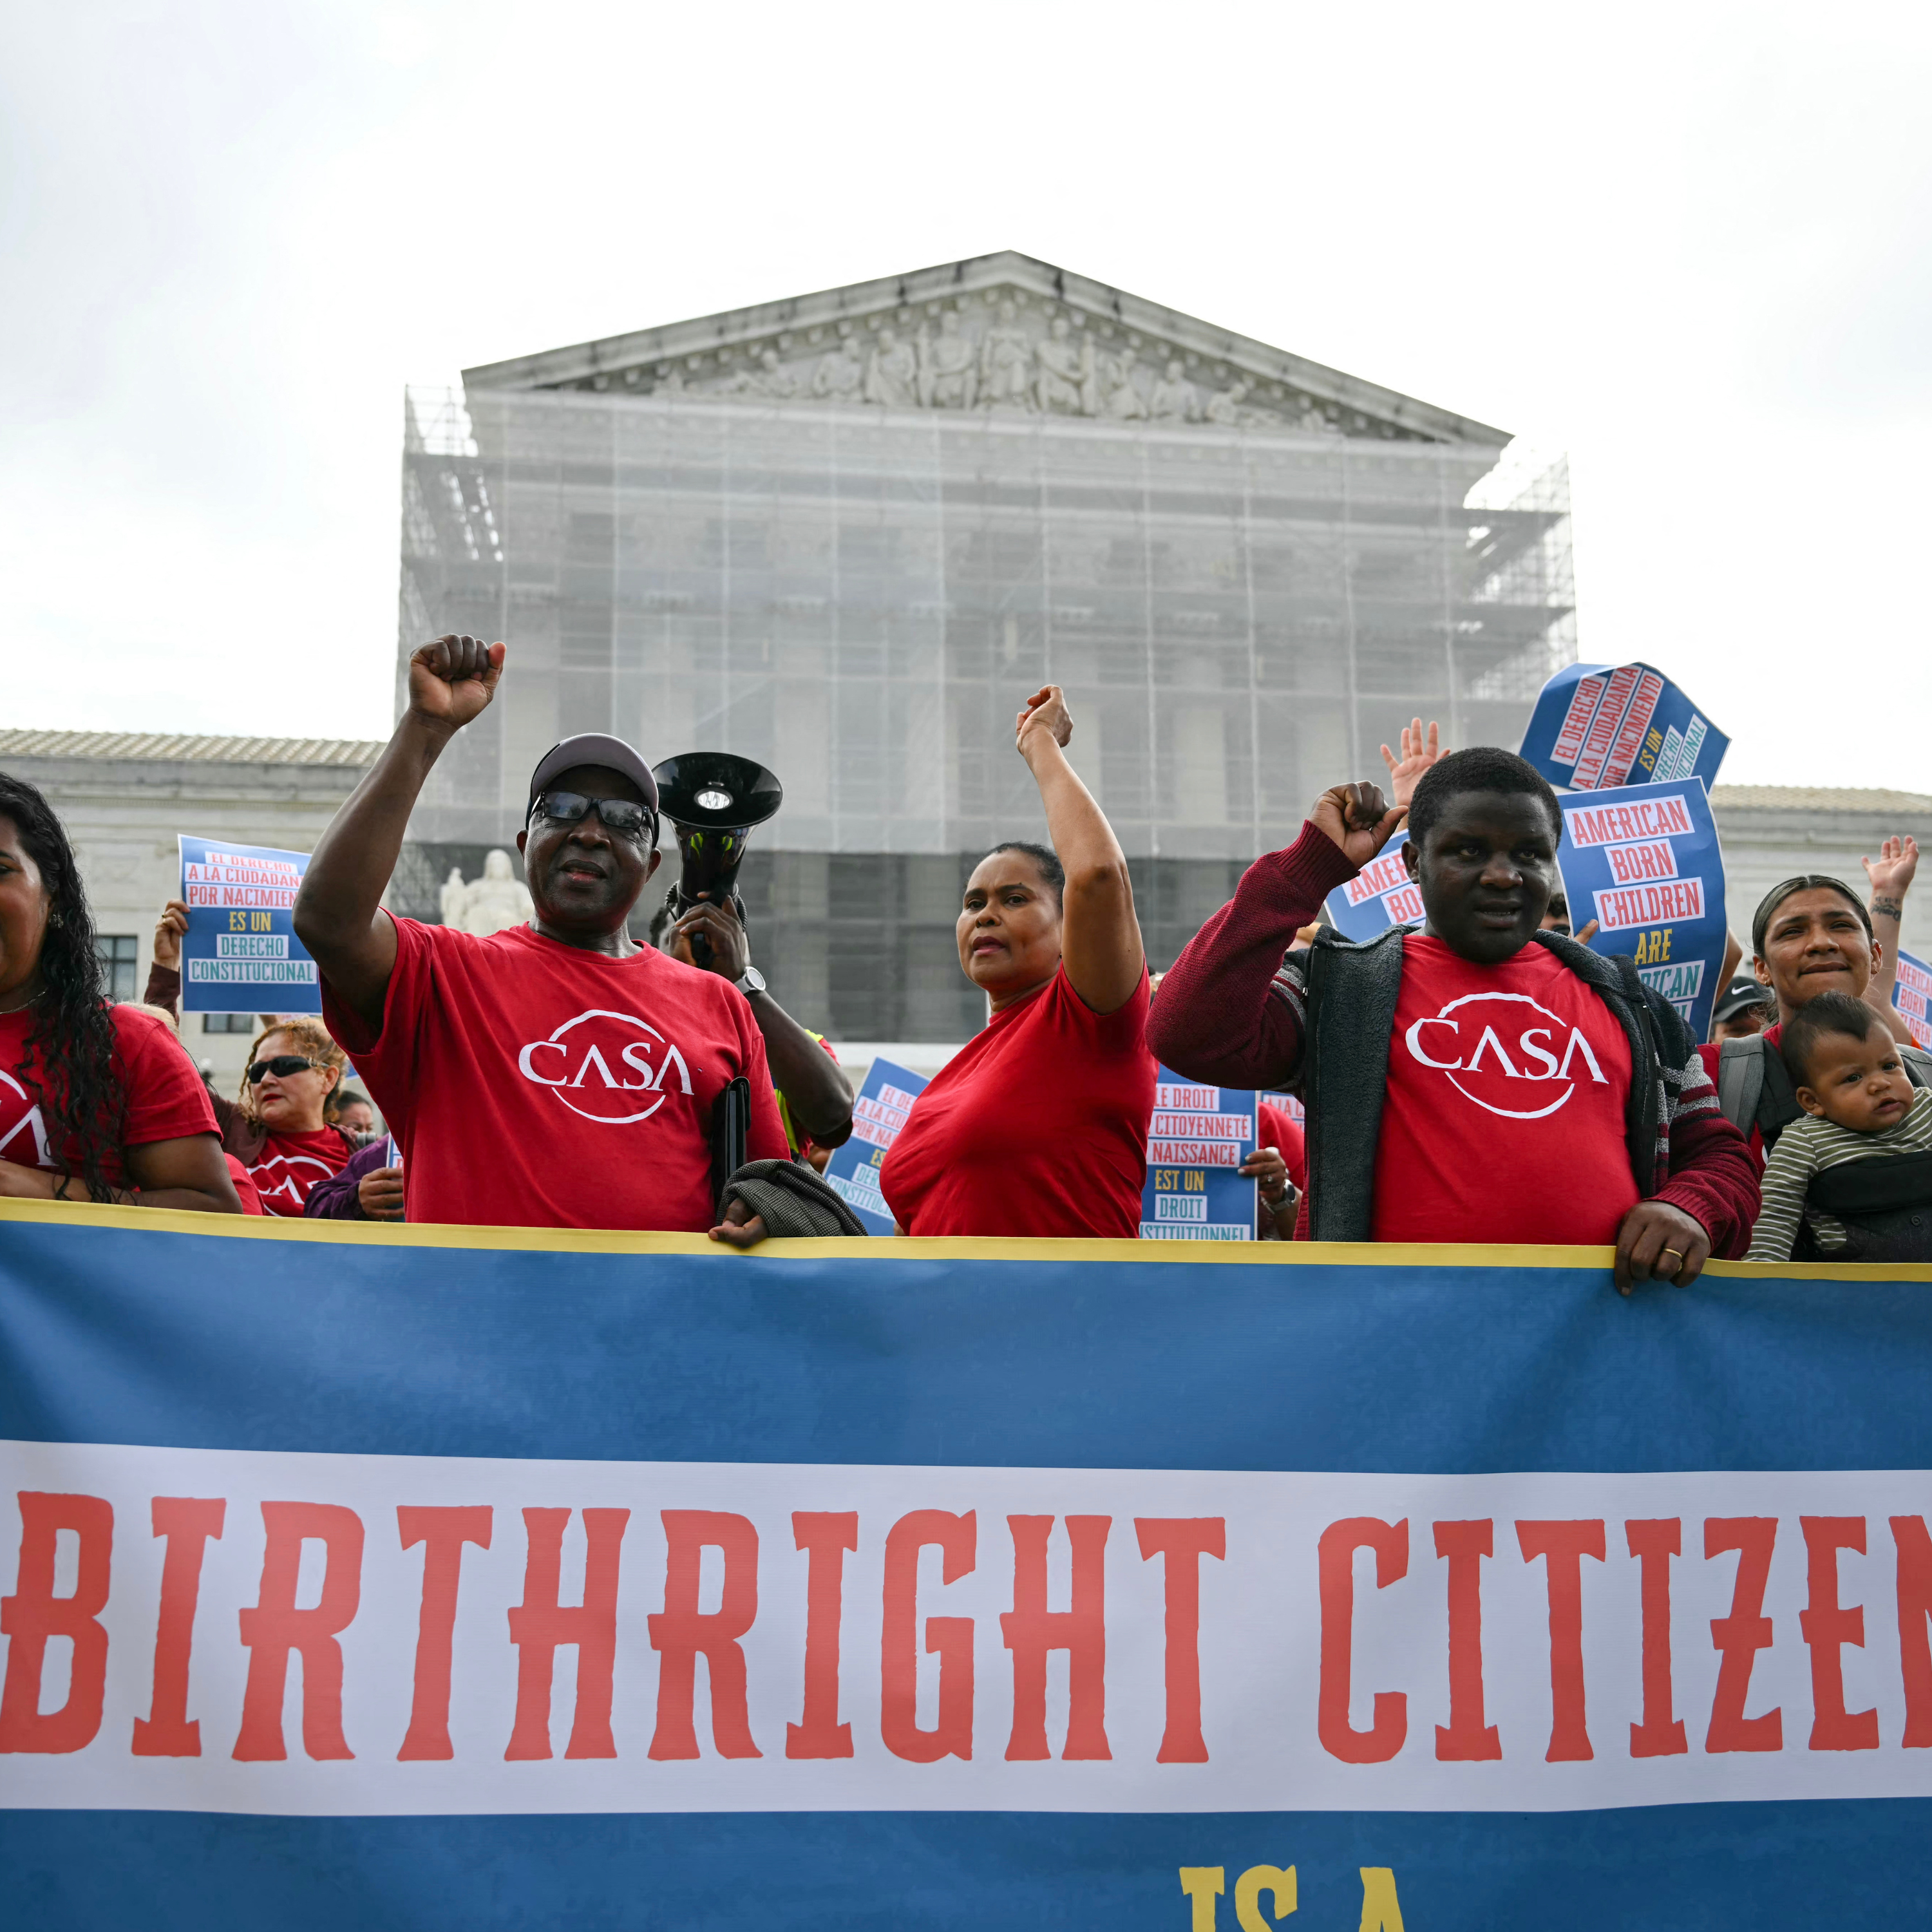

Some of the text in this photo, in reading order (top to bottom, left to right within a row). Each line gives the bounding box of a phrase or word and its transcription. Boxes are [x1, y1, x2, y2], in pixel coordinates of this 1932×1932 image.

[1555, 678, 1602, 760] EL DERECHO
[1611, 675, 1661, 764] NACIMIENTO
[1638, 726, 1663, 772] ES UN
[1578, 757, 1602, 776] LA
[1574, 777, 1595, 790] A
[1571, 800, 1690, 845] AMERICAN
[189, 865, 198, 880] A
[204, 867, 221, 881] LA
[211, 853, 292, 873] EL DERECHO
[1609, 845, 1674, 882] BORN
[189, 886, 218, 905] POR
[1386, 885, 1423, 923] BO
[1599, 882, 1700, 927] CHILDREN
[229, 911, 272, 931] ES UN
[221, 936, 283, 956] DERECHO
[1634, 929, 1673, 965] ARE
[191, 961, 313, 981] CONSTITUCIONAL
[1900, 988, 1925, 1017] BORN
[1405, 1018, 1609, 1084] CASA
[518, 1041, 694, 1095] CASA
[882, 1086, 896, 1104] EL
[1173, 1088, 1215, 1109] DROIT
[857, 1099, 868, 1115] A
[868, 1103, 884, 1121] LA
[1155, 1114, 1248, 1138] CITOYENNETÉ
[1152, 1142, 1235, 1165] NAISSANCE
[1155, 1170, 1204, 1191] EST UN
[1159, 1197, 1203, 1218] DROIT
[0, 1491, 1226, 1763] BIRTHRIGHT
